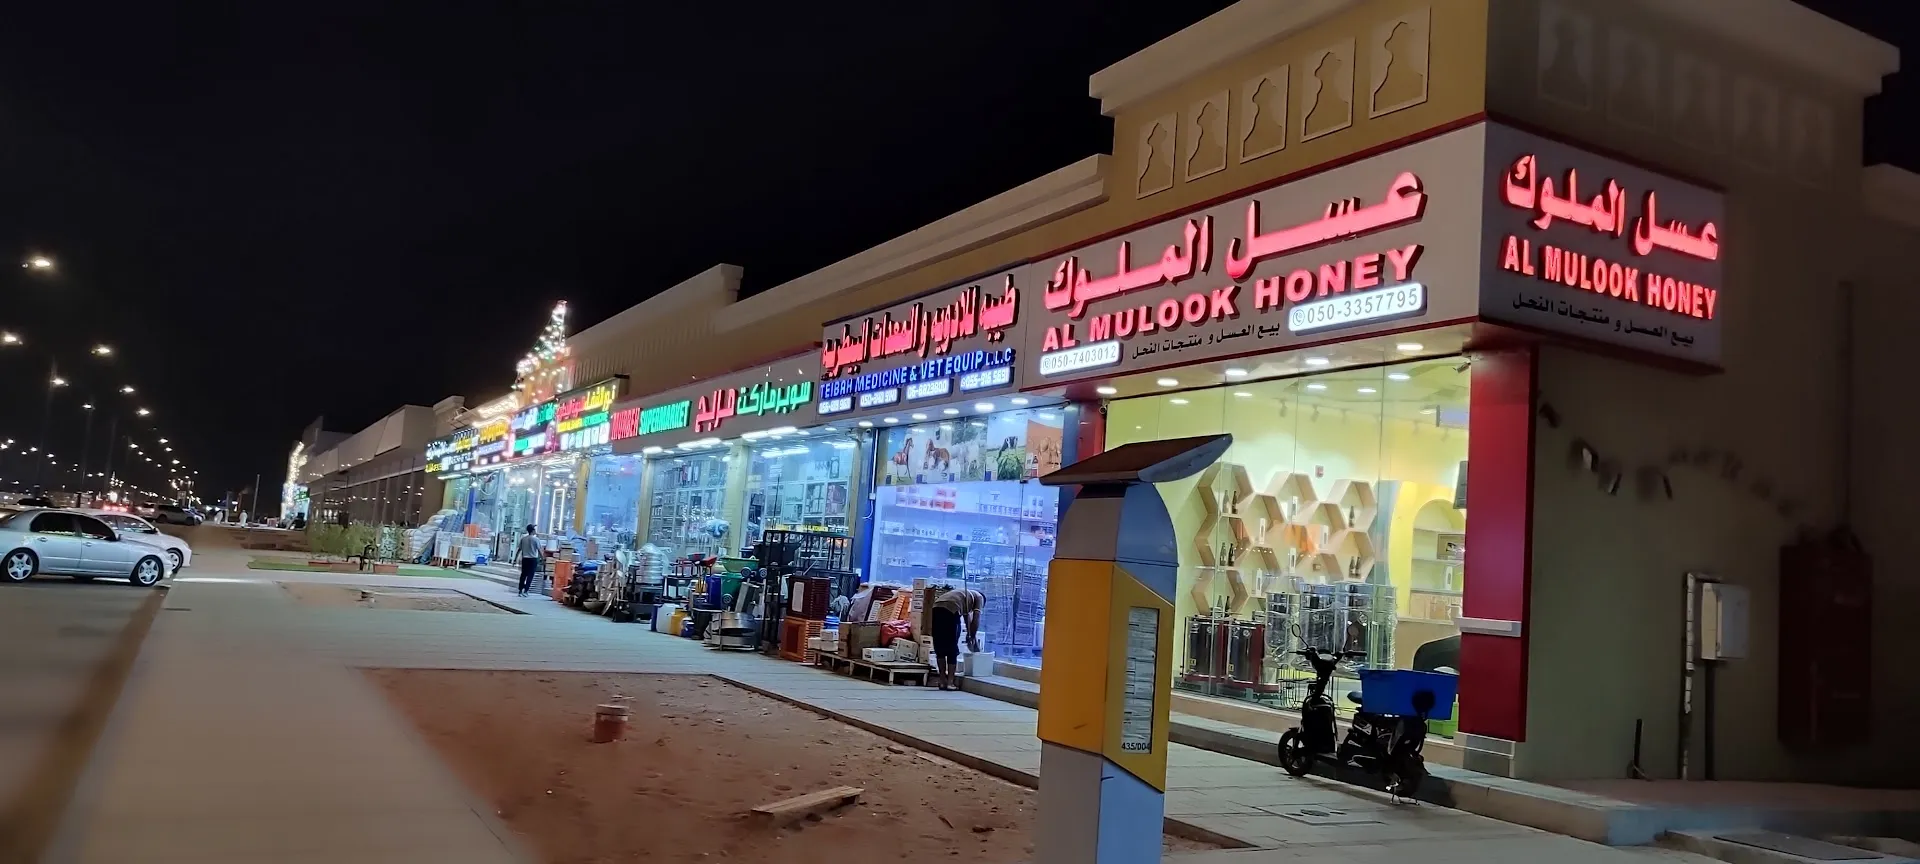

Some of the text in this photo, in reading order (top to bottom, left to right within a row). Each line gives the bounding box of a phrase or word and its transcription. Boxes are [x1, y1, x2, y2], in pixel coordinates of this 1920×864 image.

[1504, 152, 1719, 261] عسل الملوك
[1044, 171, 1423, 318] عسل الملوك
[1503, 234, 1719, 321] AL MULOOK HONEY
[1042, 244, 1423, 351] AL MULOOK HONEY
[1306, 288, 1418, 324] 050-3357795
[1512, 293, 1555, 313] النحل
[1557, 299, 1610, 325] منتجات
[1132, 322, 1281, 360] بيع العسل و منتجات النحل
[1624, 319, 1669, 339] العسل
[820, 376, 853, 399] TEIBAH
[855, 366, 908, 393] MEDICINE
[909, 364, 917, 382] &
[921, 357, 944, 380] VET
[946, 350, 984, 375] EQUIP
[1051, 345, 1117, 369] 050-7403012
[639, 400, 690, 436] SUPERMARKET
